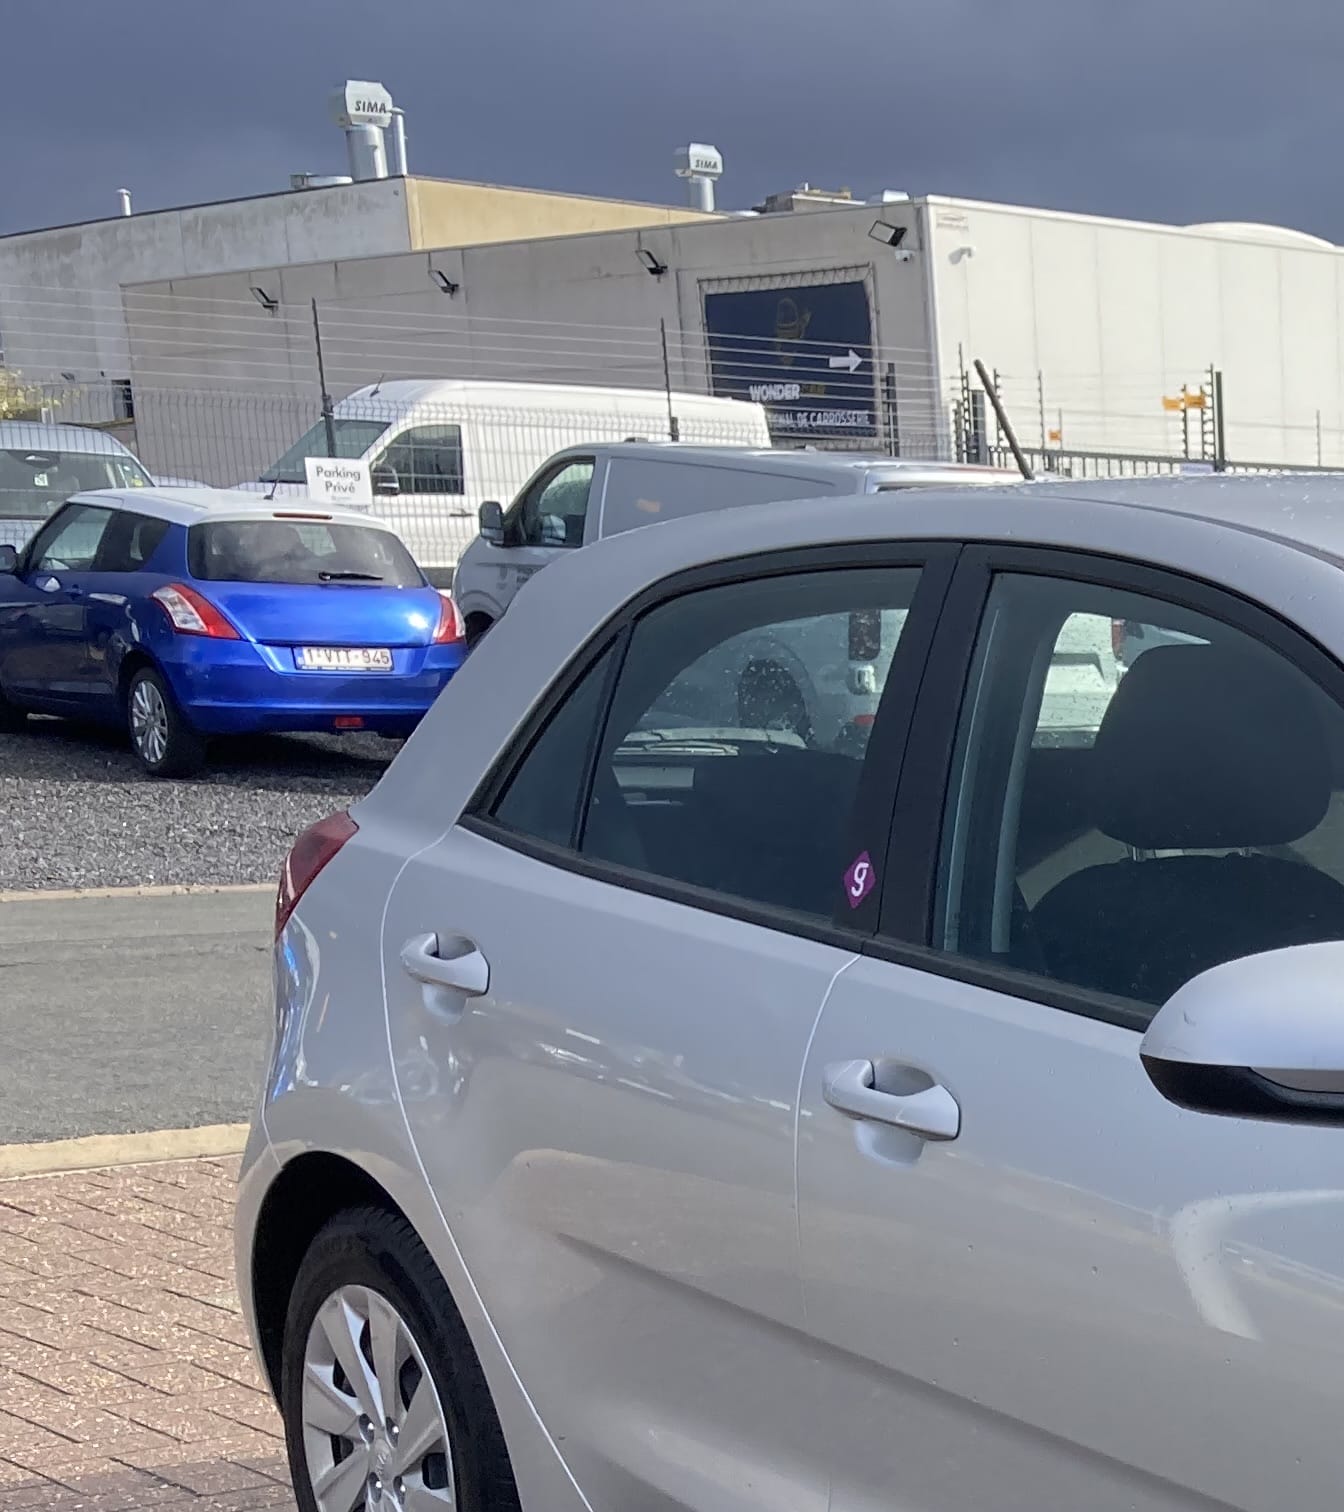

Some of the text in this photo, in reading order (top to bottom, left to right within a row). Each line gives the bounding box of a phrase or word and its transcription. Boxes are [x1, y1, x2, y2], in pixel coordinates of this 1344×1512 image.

[355, 100, 387, 113] SIMA
[695, 159, 719, 169] SIMA
[316, 466, 361, 481] Parking
[325, 481, 355, 493] Privé
